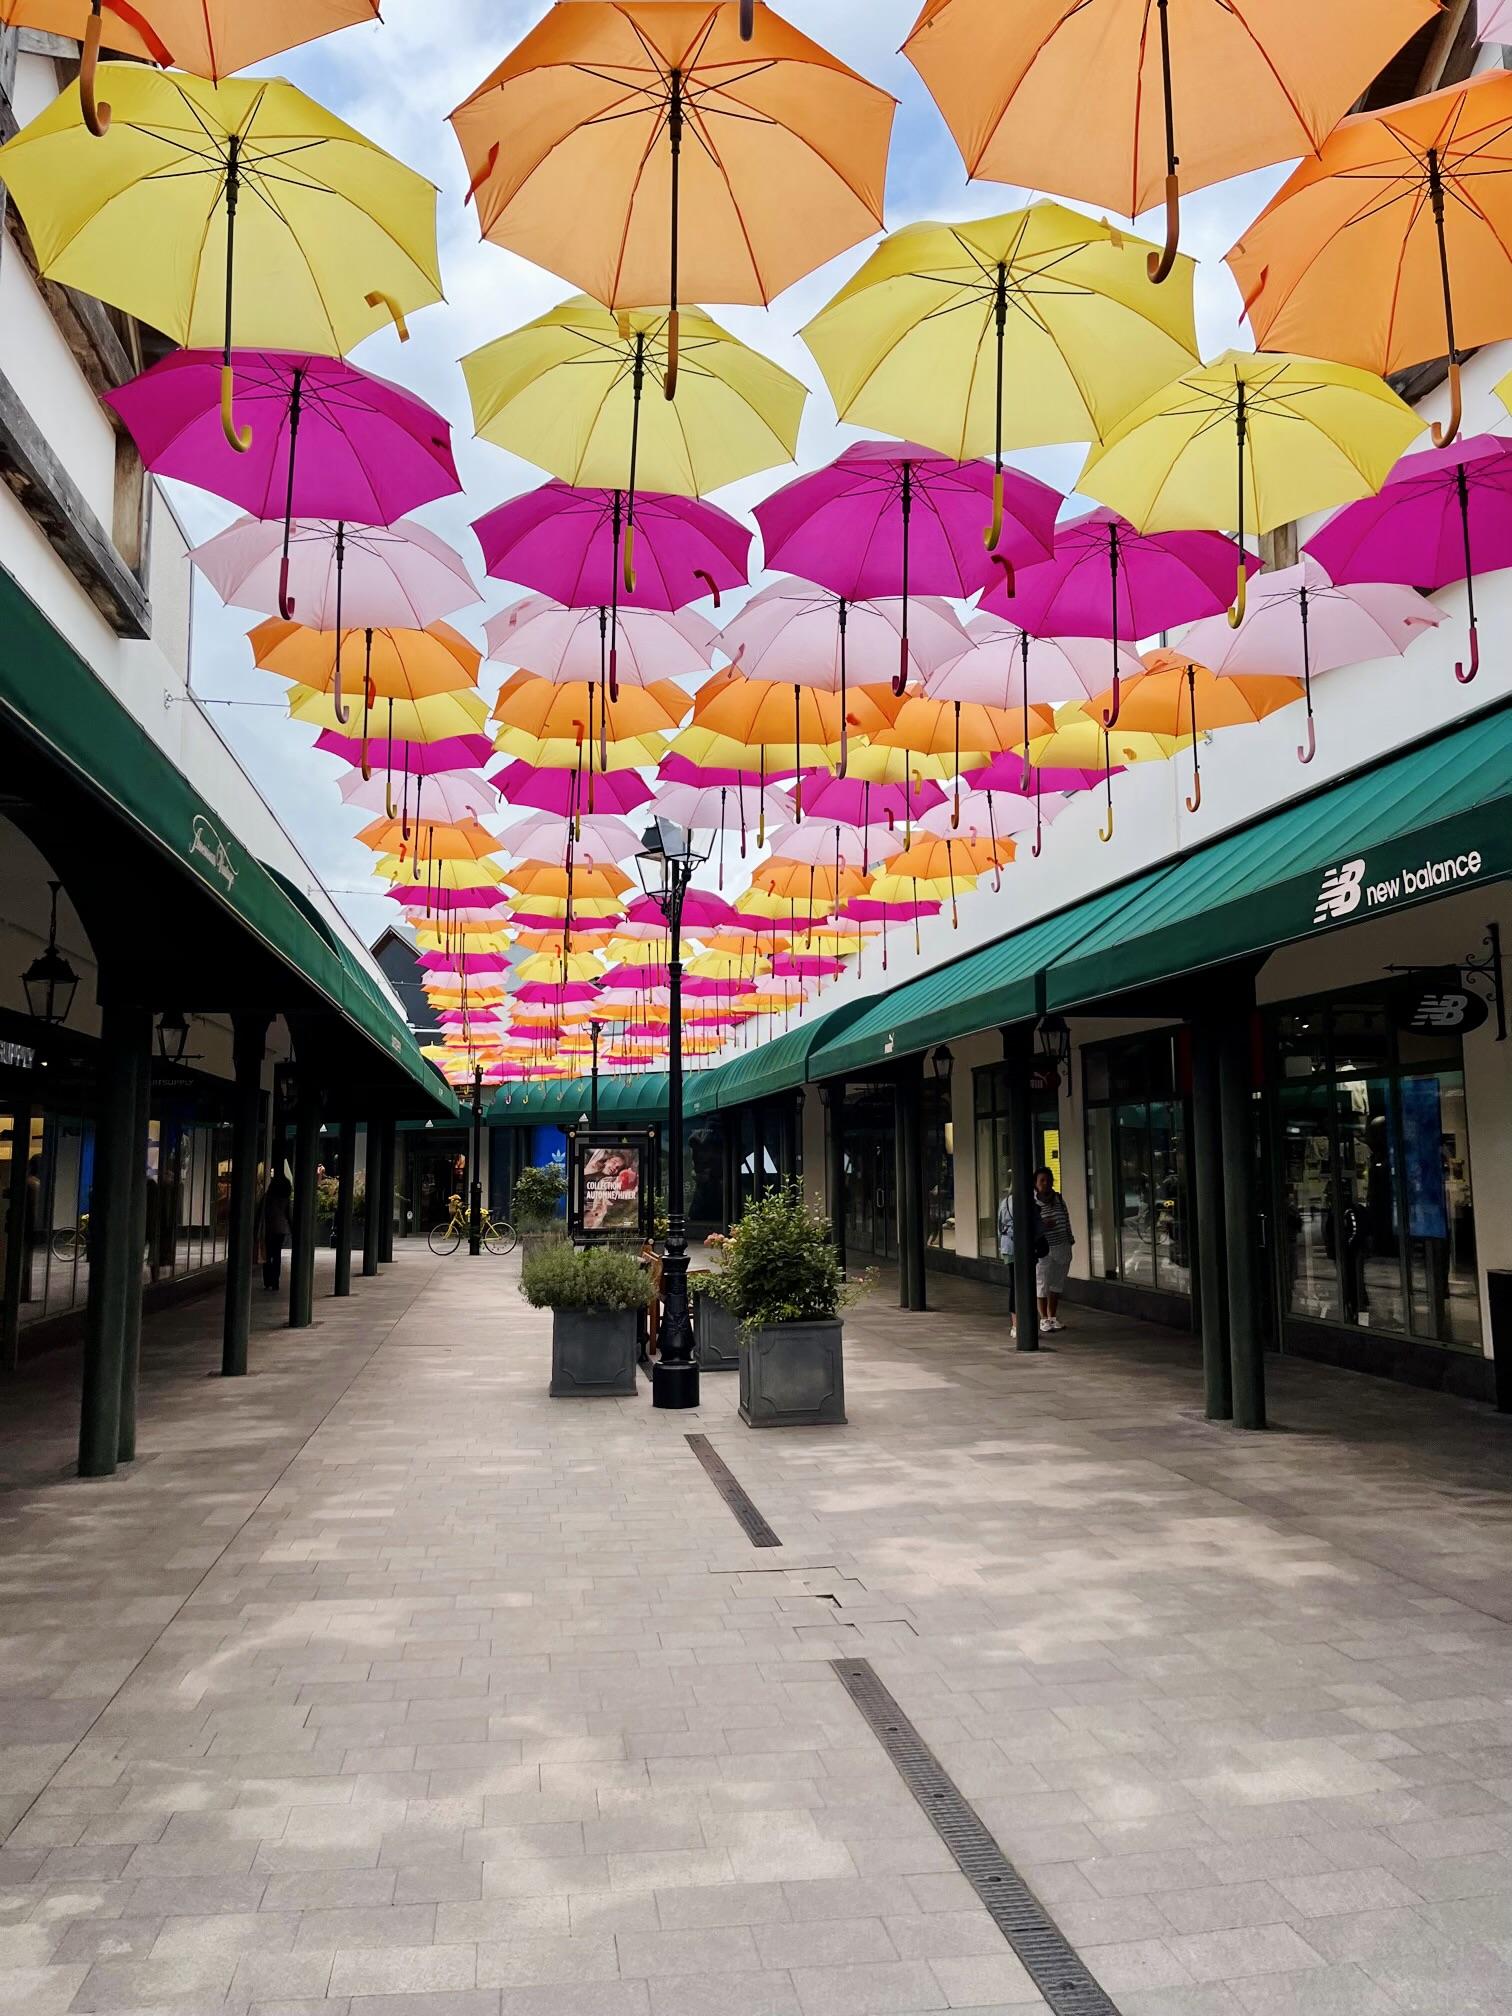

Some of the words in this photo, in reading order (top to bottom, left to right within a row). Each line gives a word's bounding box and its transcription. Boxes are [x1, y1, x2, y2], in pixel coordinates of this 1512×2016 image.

[1366, 877, 1400, 906] new
[1402, 850, 1482, 894] balance
[586, 1181, 622, 1190] COLLECTION
[586, 1190, 636, 1200] AUTOMNE/HIVER
